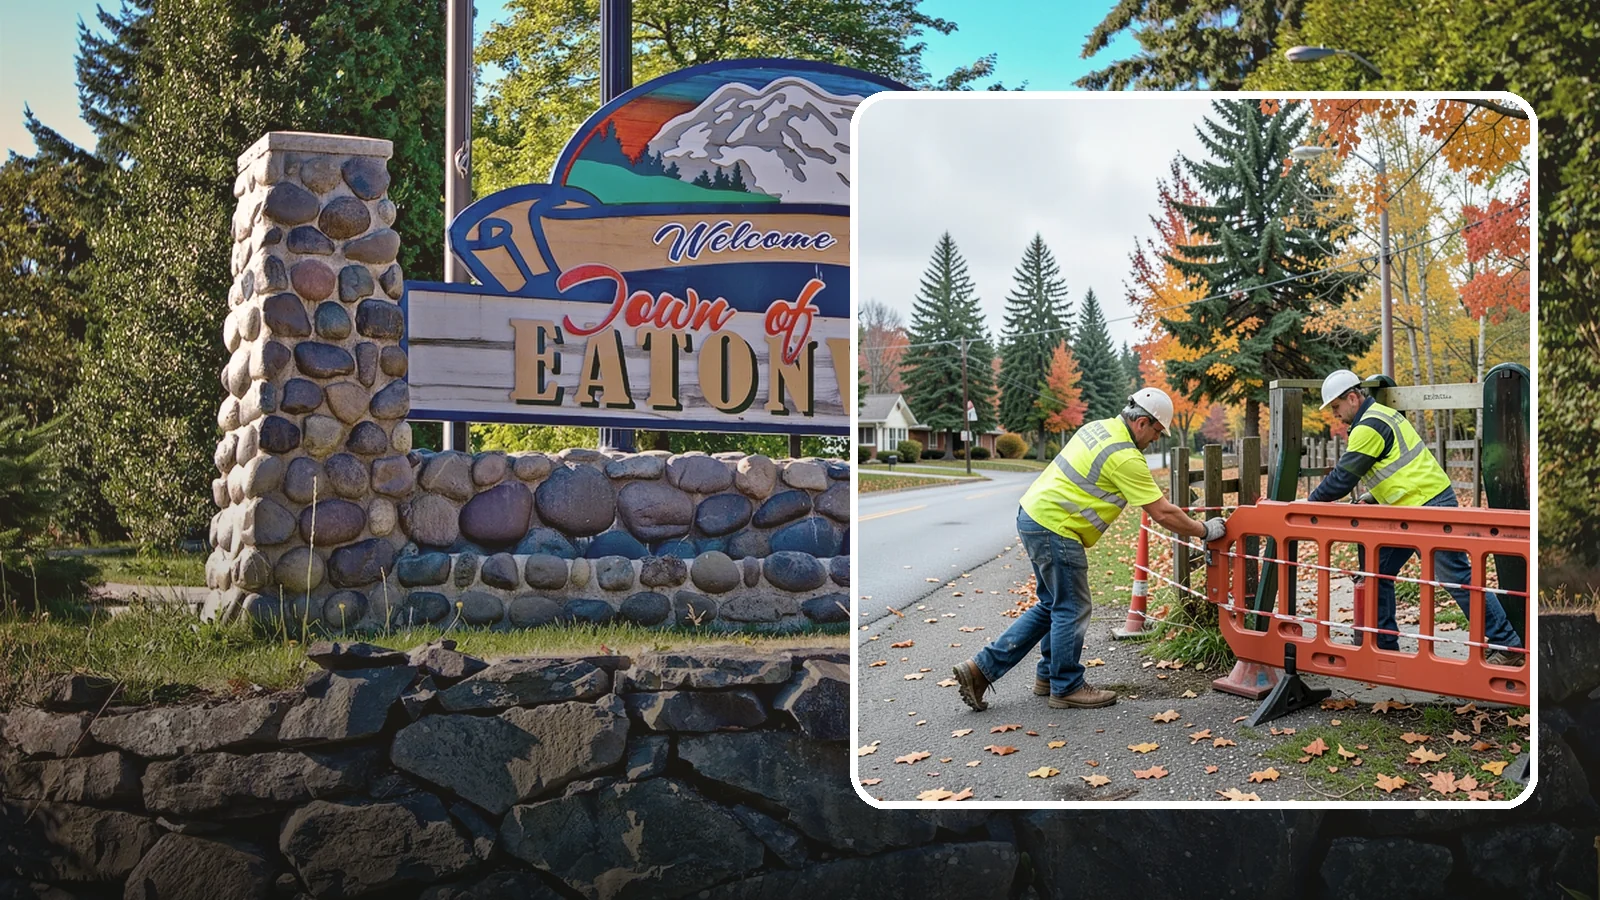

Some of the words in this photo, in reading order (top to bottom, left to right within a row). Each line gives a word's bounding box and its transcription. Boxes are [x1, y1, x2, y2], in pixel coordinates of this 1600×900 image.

[652, 221, 837, 263] Welcome
[556, 263, 736, 336] Town
[764, 278, 826, 365] of
